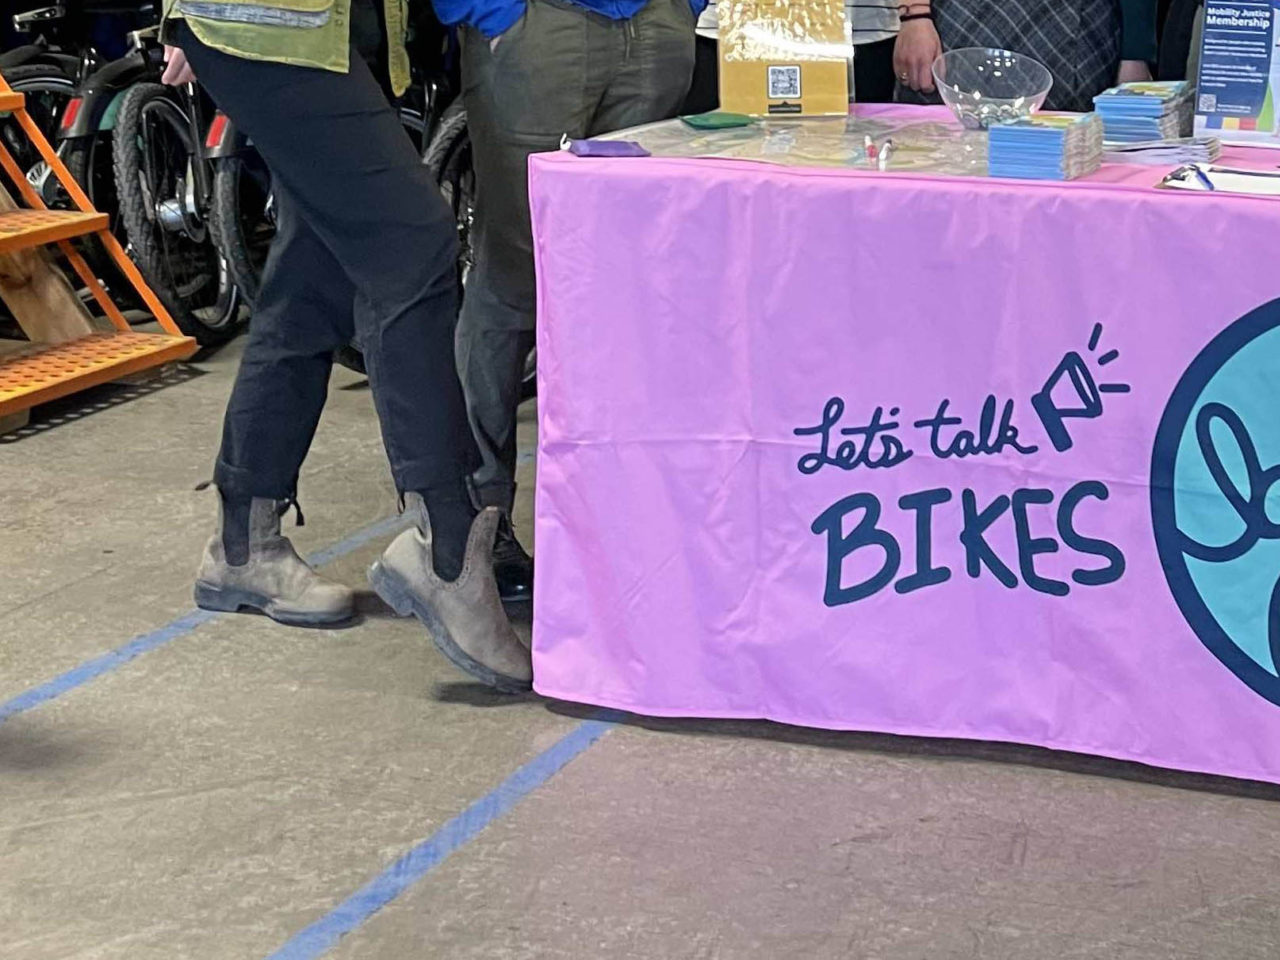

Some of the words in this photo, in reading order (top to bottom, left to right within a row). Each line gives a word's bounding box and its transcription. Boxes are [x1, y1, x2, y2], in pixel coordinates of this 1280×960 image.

[1206, 15, 1271, 29] Membership
[1207, 7, 1241, 19] Mobility
[1241, 8, 1271, 18] Justice
[793, 396, 914, 475] Let's
[914, 393, 1039, 459] talk
[811, 480, 1126, 608] BIKES
